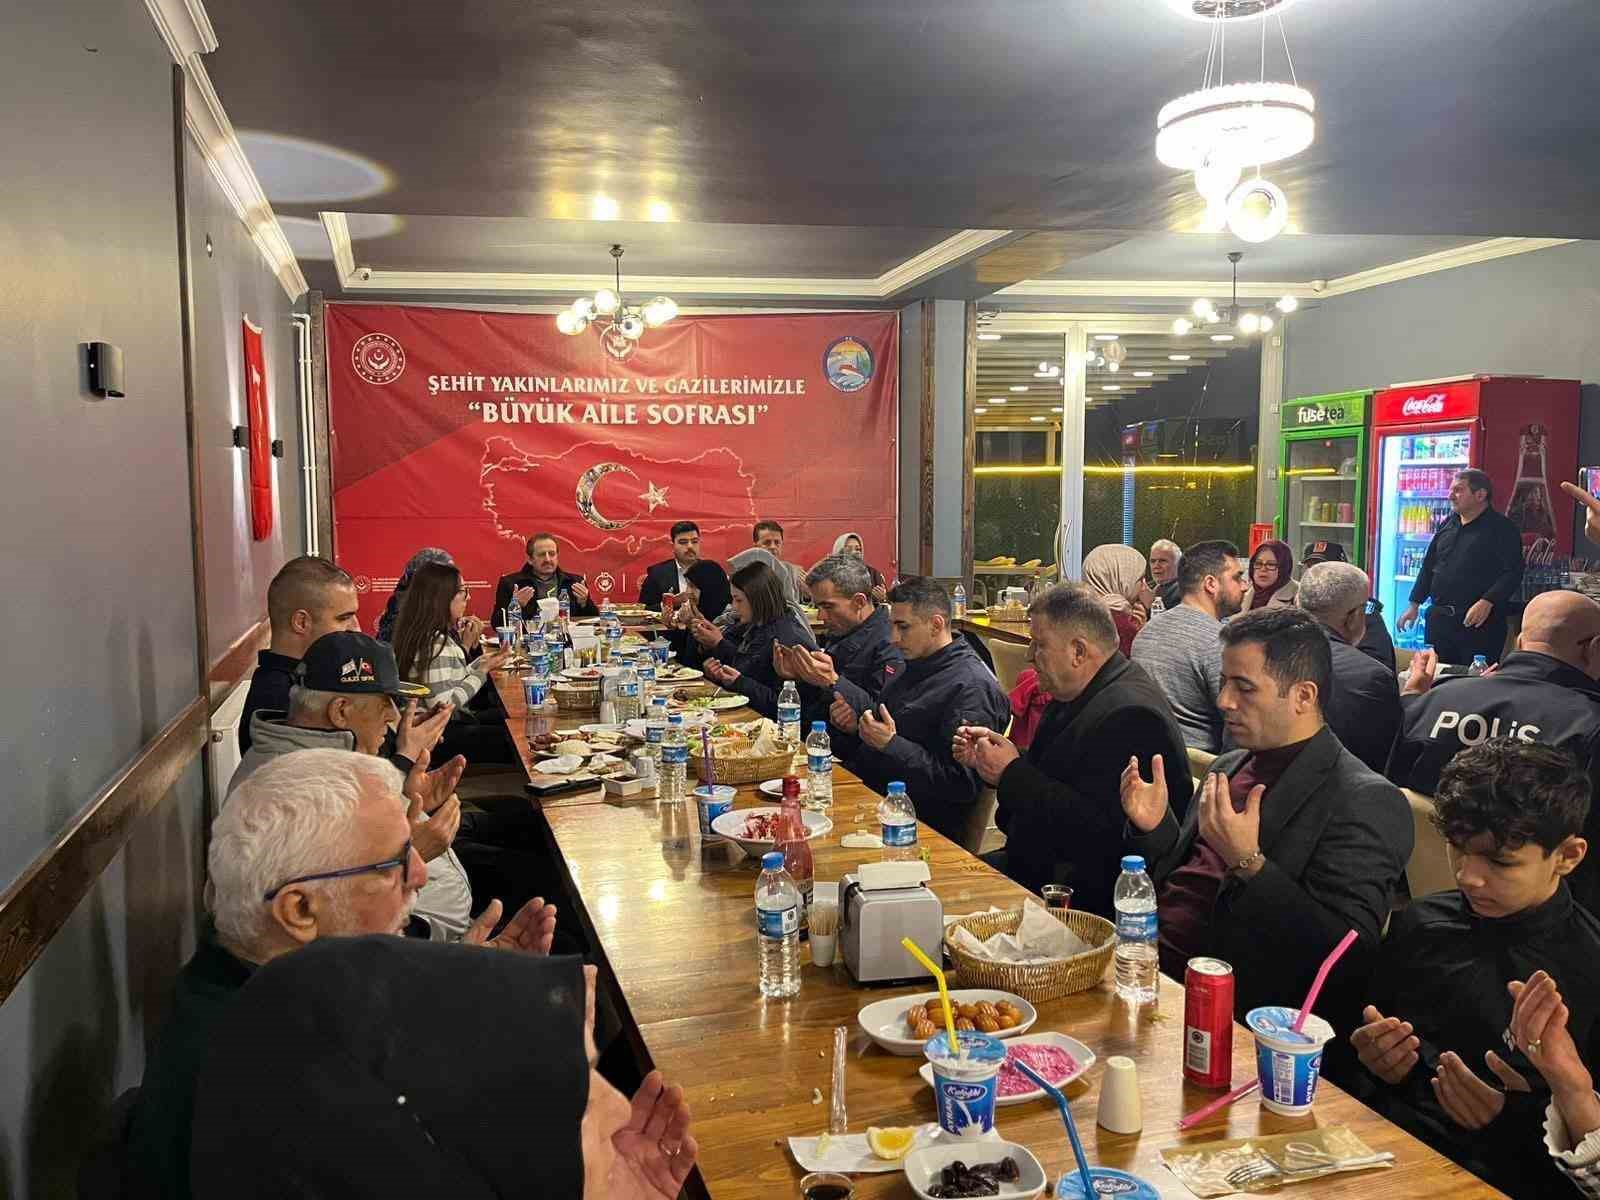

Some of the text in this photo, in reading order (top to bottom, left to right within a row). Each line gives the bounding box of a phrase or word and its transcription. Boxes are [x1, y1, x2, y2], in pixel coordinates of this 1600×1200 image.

[428, 372, 806, 395] ŞEHİT YAKINLARIMIZ VE GAZİLERİMİZLE
[582, 398, 638, 424] AİLE
